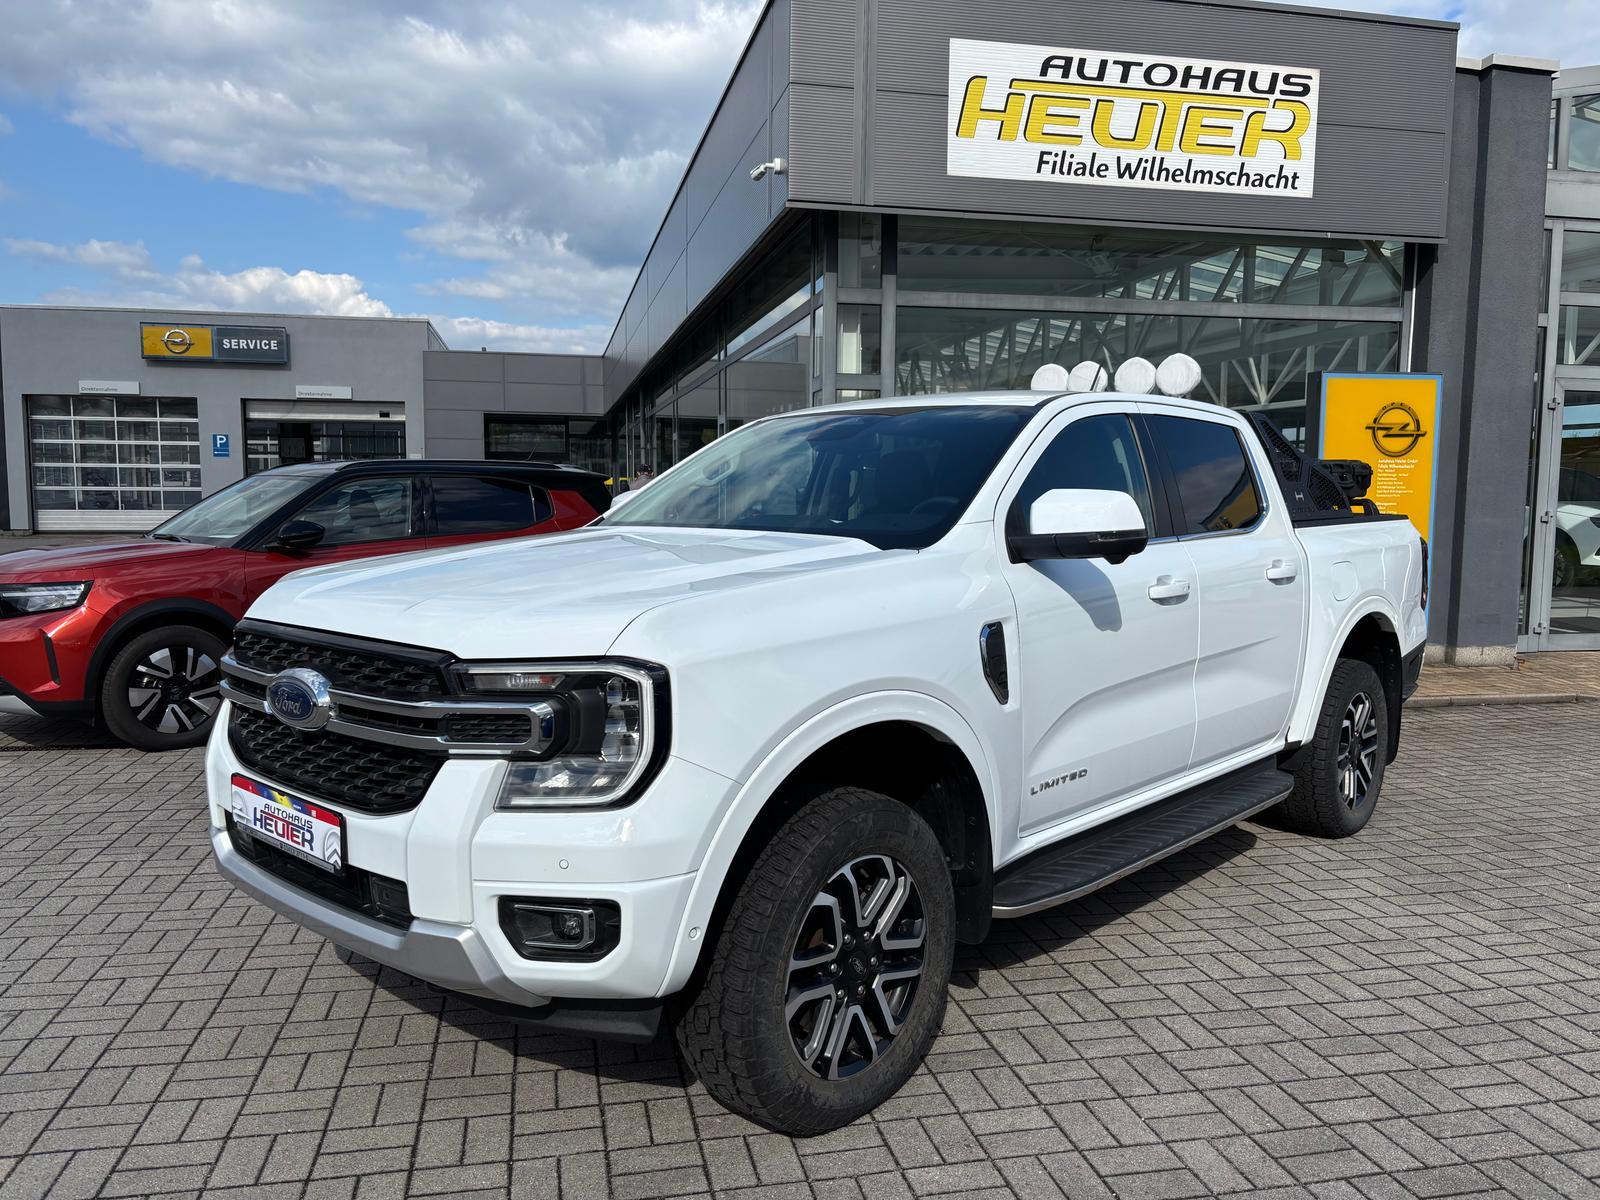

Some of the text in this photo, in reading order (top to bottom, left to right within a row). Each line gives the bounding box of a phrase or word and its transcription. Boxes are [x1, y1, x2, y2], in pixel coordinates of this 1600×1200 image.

[1039, 55, 1313, 98] AUTOHAUS
[955, 75, 1312, 161] HEUTER
[1036, 150, 1300, 190] Filiale Wilhelmschacht
[222, 338, 278, 350] SERVICE
[216, 435, 227, 448] P
[275, 687, 302, 714] Ford
[1030, 768, 1088, 796] LIMITED
[253, 806, 315, 852] HEUTER
[263, 803, 313, 830] AUTOHAUS
